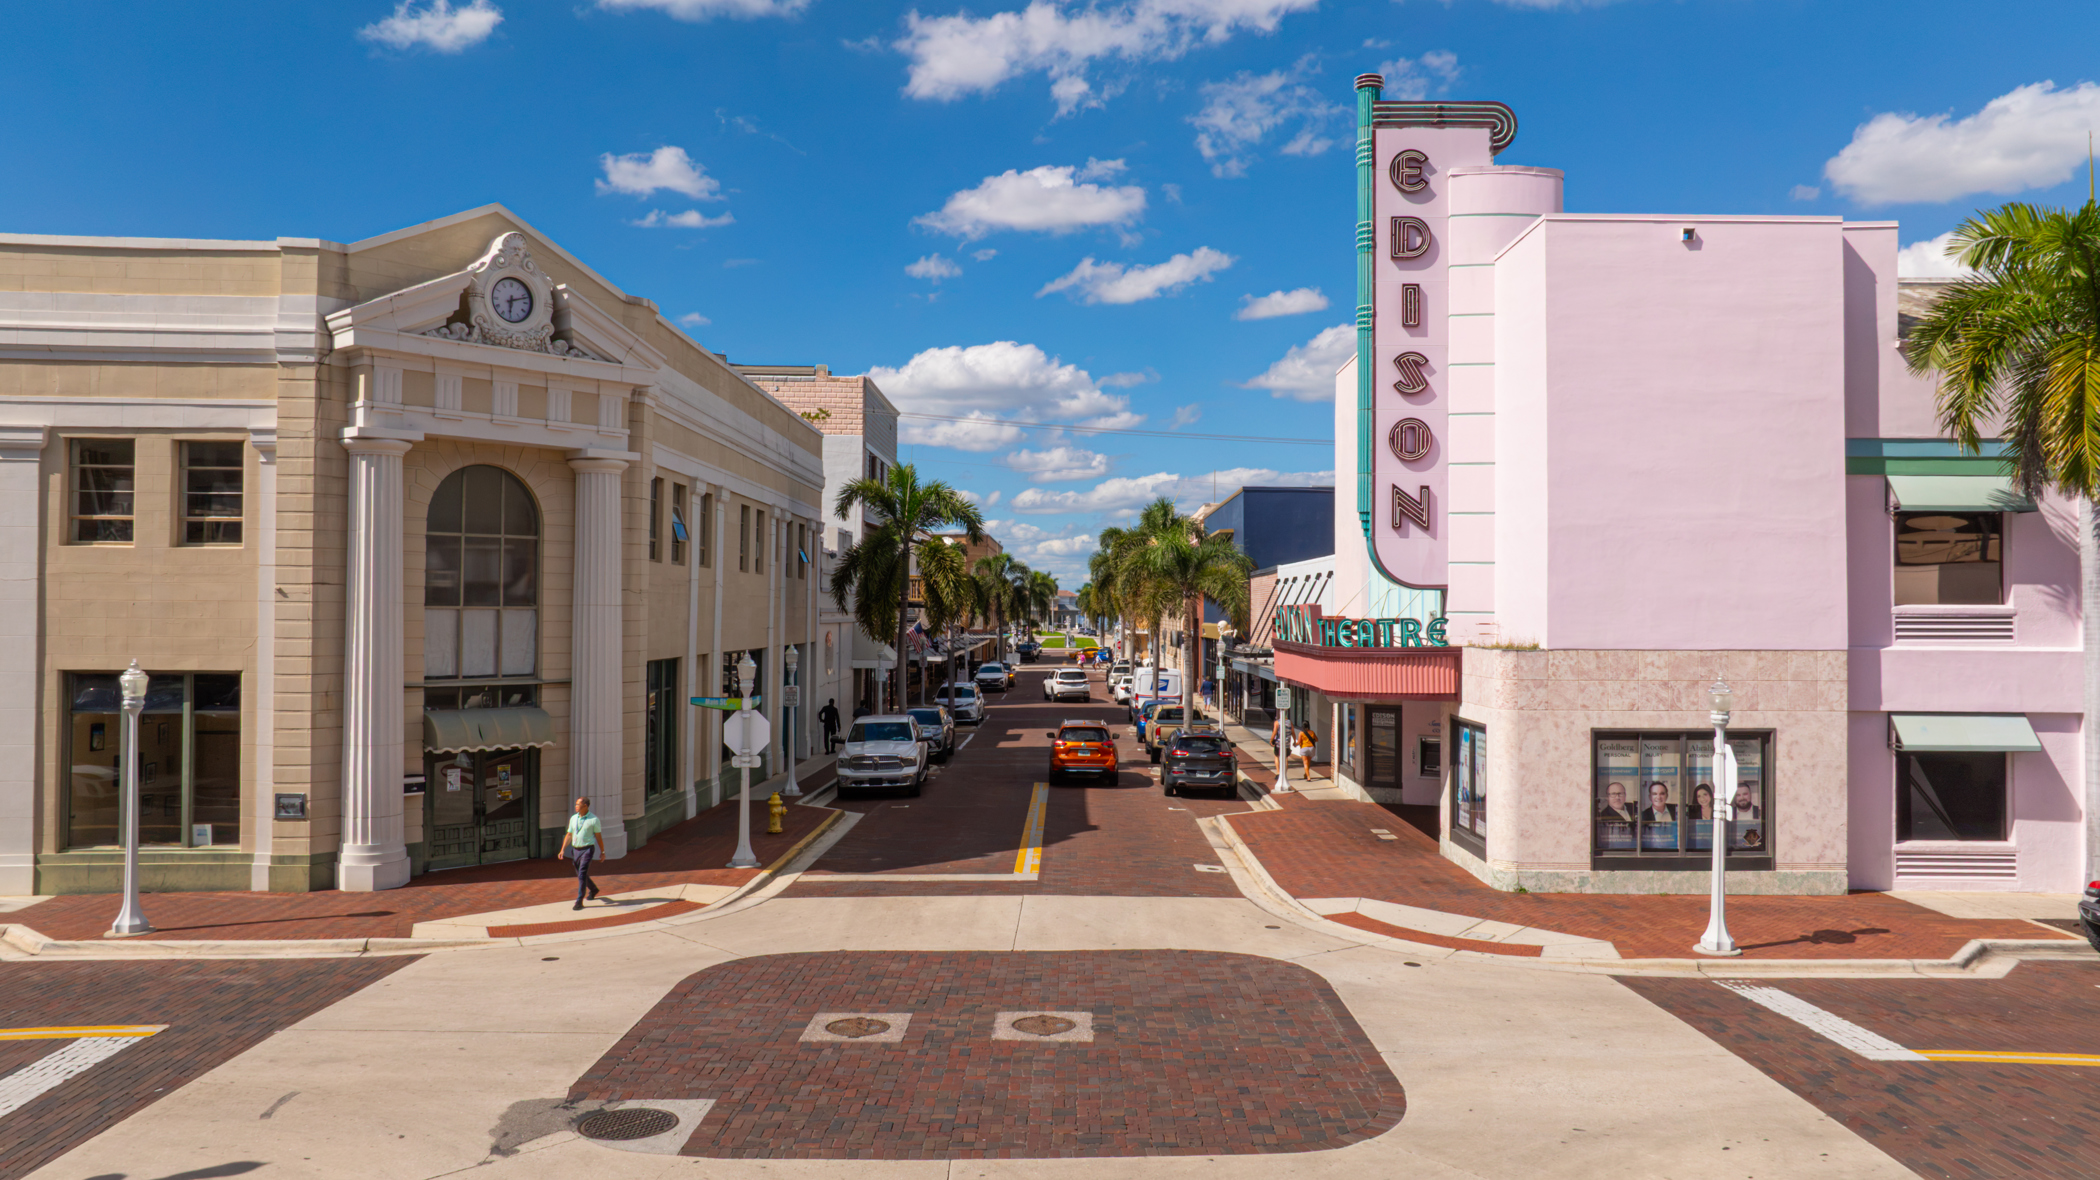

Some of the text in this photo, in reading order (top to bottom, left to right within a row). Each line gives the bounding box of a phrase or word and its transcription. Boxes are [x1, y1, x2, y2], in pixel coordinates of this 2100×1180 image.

[1389, 149, 1432, 530] EDISON
[1276, 605, 1449, 648] EDISON THEATRE
[1600, 743, 1715, 752] Goldberg Noone Abrah
